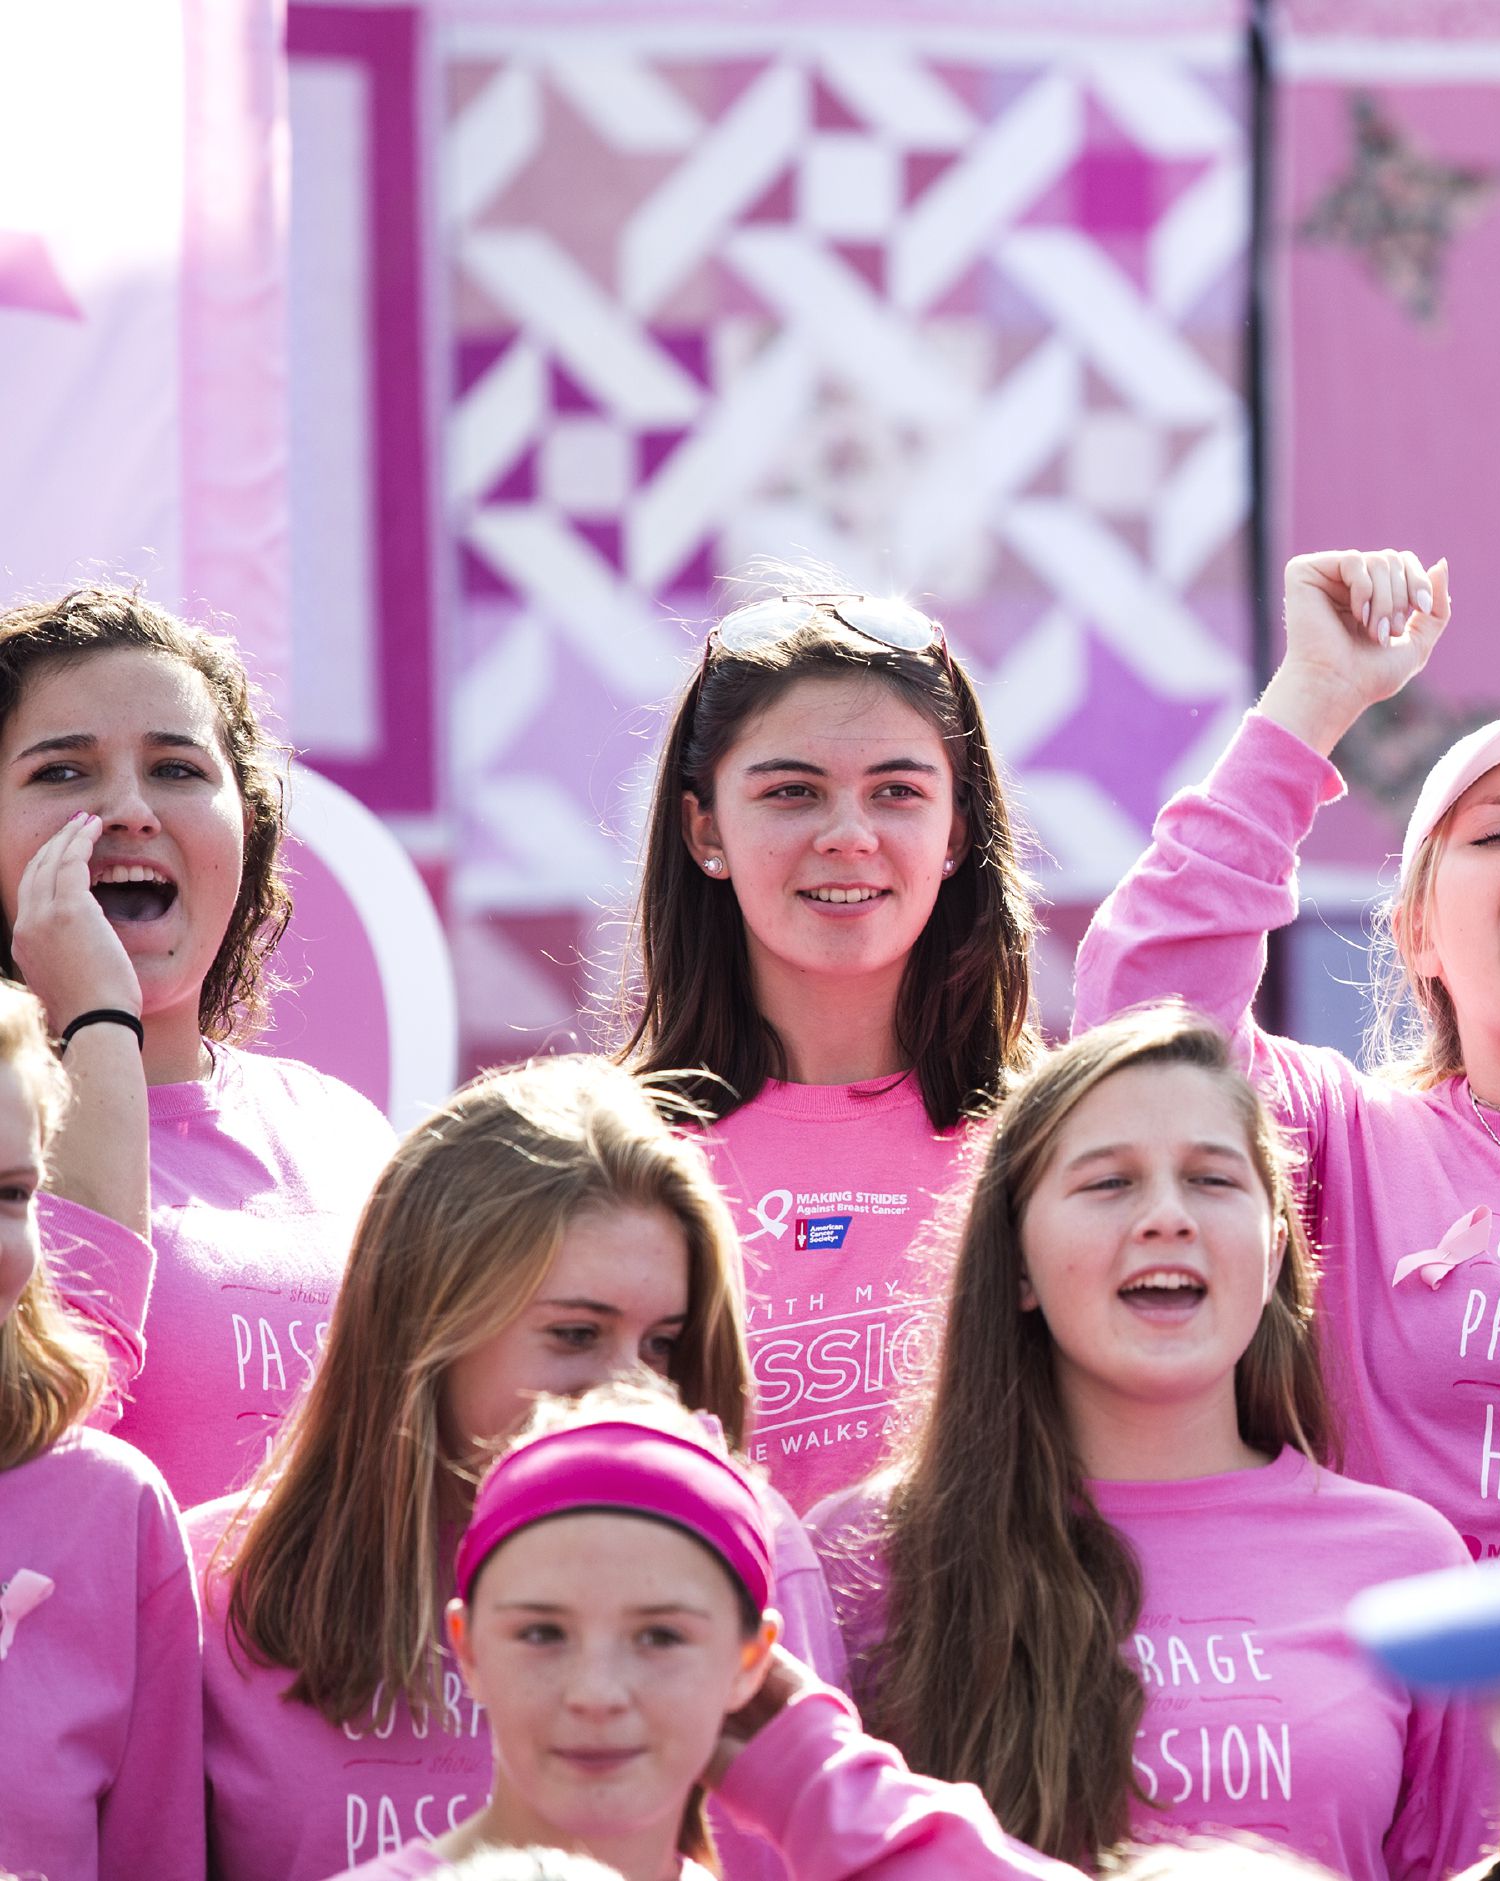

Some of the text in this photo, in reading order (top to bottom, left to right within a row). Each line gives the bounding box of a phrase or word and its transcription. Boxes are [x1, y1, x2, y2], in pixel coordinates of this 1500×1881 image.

[796, 1191, 908, 1205] MAKING STRIDES
[797, 1204, 835, 1216] Against
[837, 1203, 869, 1214] Breast
[810, 1224, 844, 1233] American
[810, 1231, 834, 1239] Cancer
[855, 1280, 898, 1303] MY
[781, 1421, 868, 1455] WALKS
[1134, 1632, 1272, 1687] RAGE
